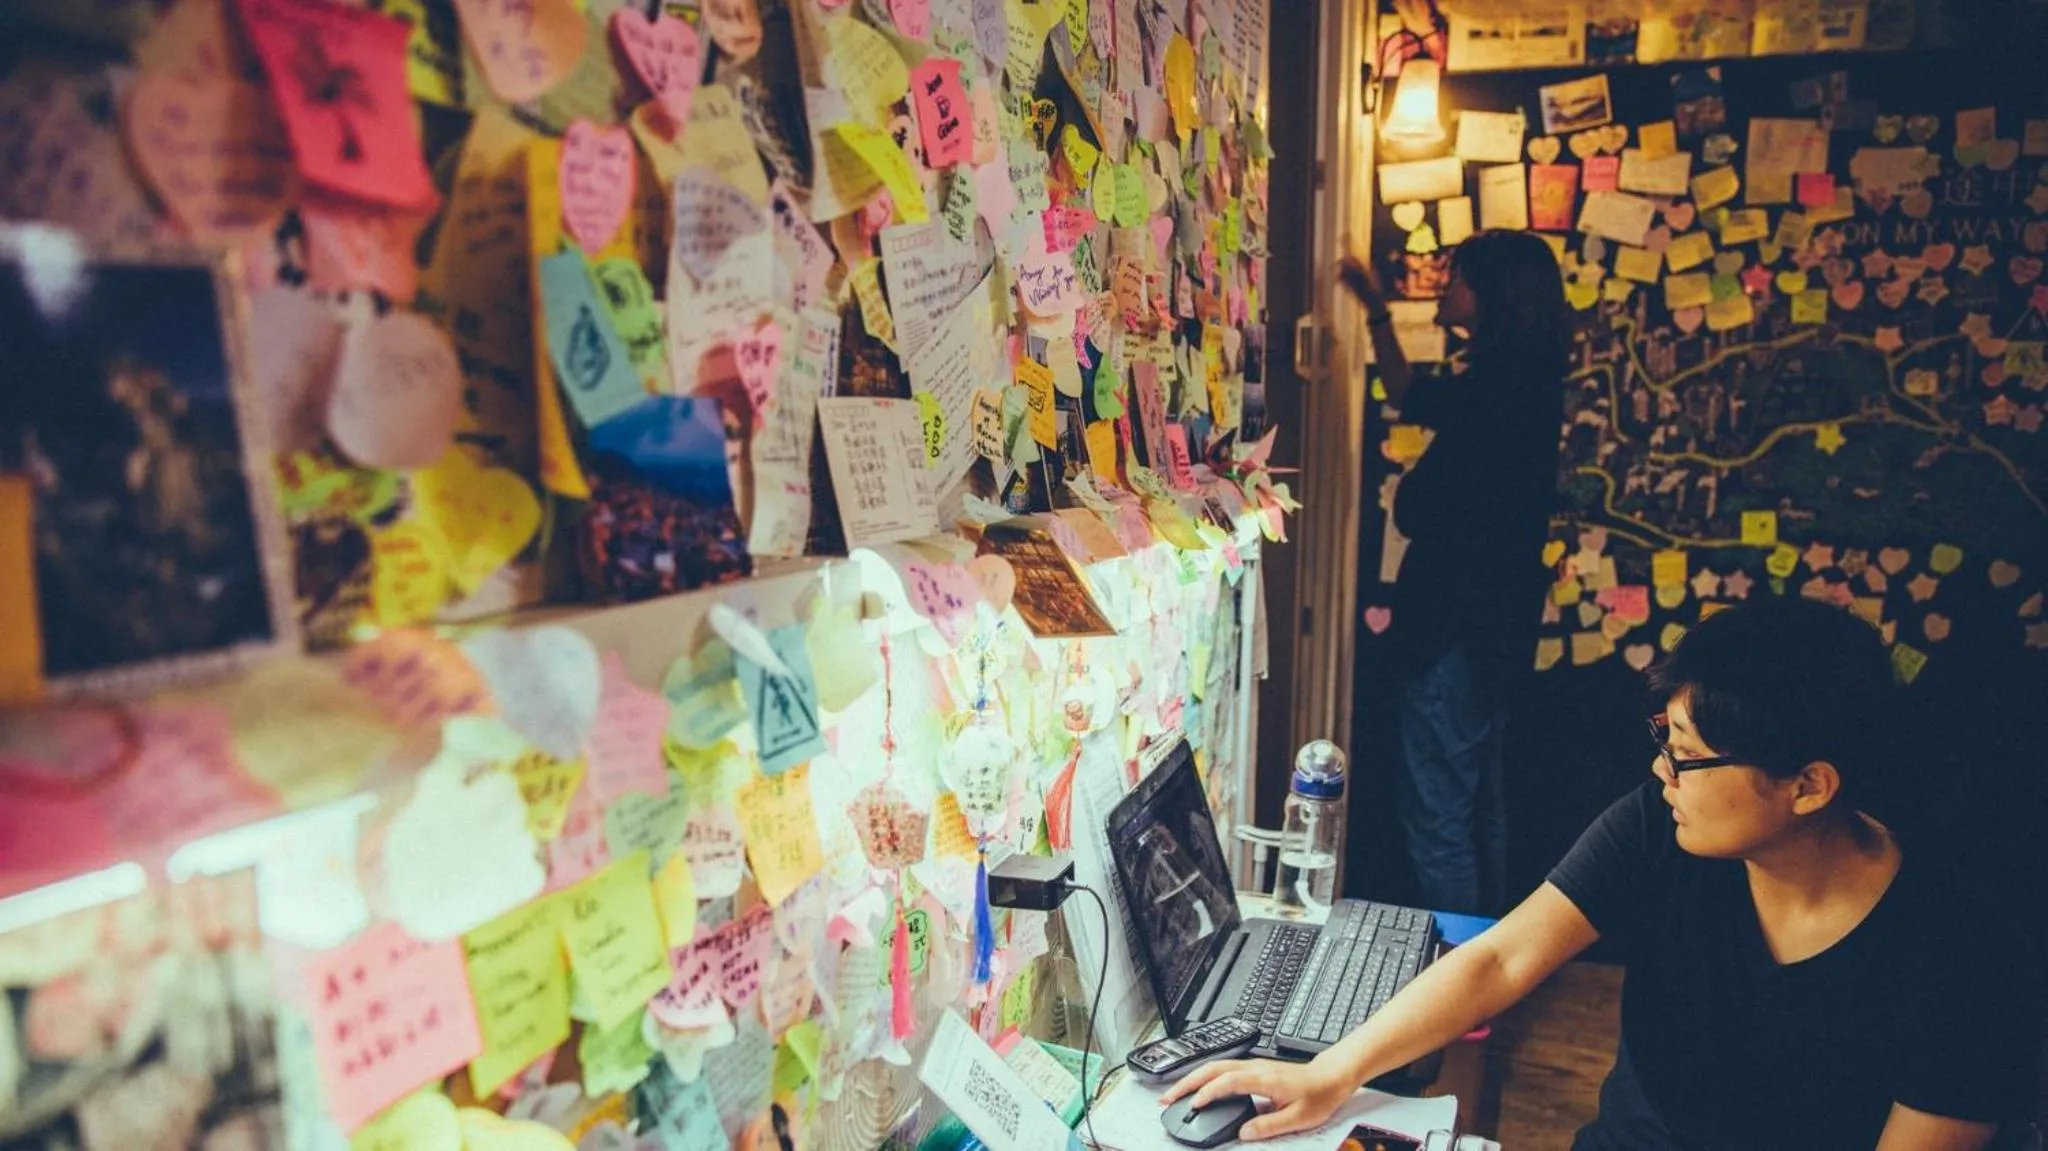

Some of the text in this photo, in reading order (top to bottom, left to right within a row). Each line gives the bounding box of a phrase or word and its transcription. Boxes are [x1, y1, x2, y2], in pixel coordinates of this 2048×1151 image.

[1843, 216, 2026, 245] ON MY WAY
